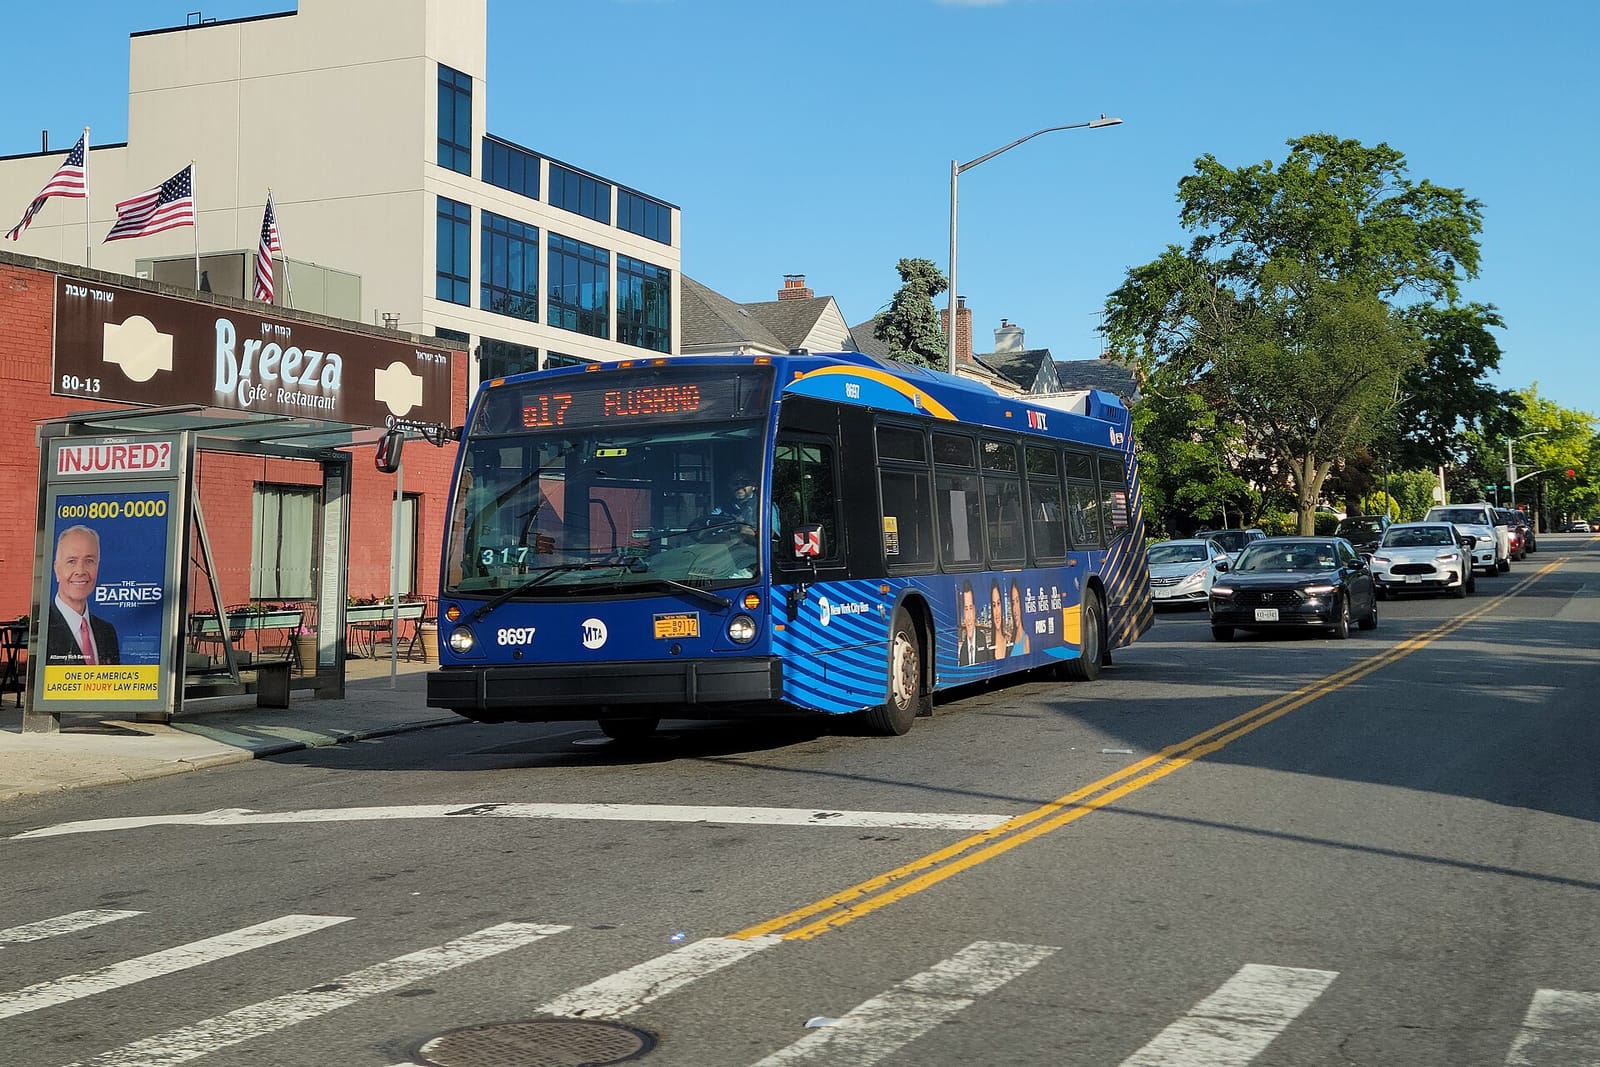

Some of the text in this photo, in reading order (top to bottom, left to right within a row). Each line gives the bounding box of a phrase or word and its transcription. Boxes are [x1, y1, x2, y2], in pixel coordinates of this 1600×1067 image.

[65, 284, 114, 302] שומר שבת
[215, 318, 342, 394] Breeza
[62, 374, 101, 393] 80-13
[238, 378, 336, 409] Cafe Restaurant
[58, 443, 170, 472] INJURED?
[95, 586, 162, 602] BARNES
[497, 627, 536, 645] 8697
[64, 671, 140, 681] ONE OF AMERICA'S
[47, 683, 158, 692] LARGEST INJURY LAW FIRMS
